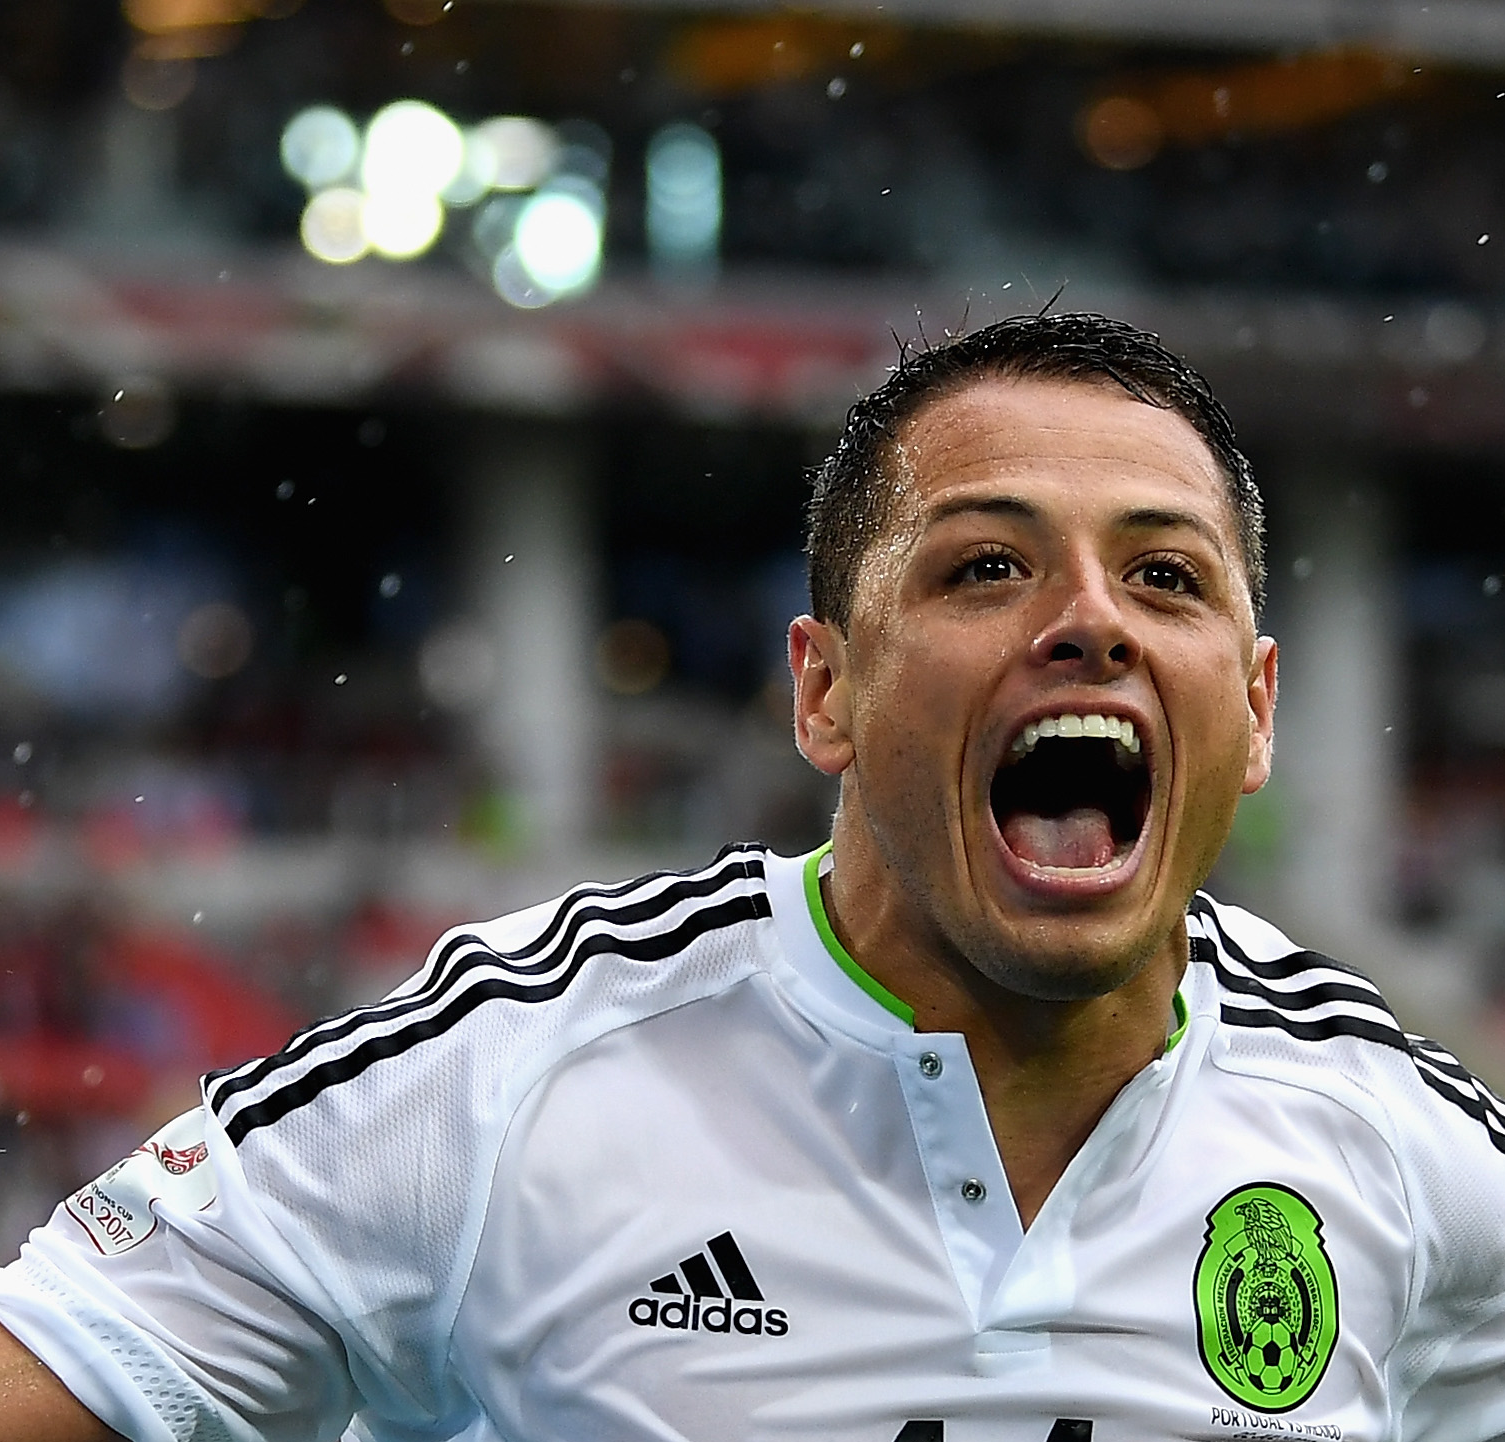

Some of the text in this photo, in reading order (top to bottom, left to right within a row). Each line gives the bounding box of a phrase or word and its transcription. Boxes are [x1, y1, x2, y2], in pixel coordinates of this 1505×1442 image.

[96, 1206, 134, 1246] 2017
[117, 1206, 134, 1221] CUP
[628, 1294, 789, 1336] adidas
[1211, 1407, 1284, 1431] PORTUGAL
